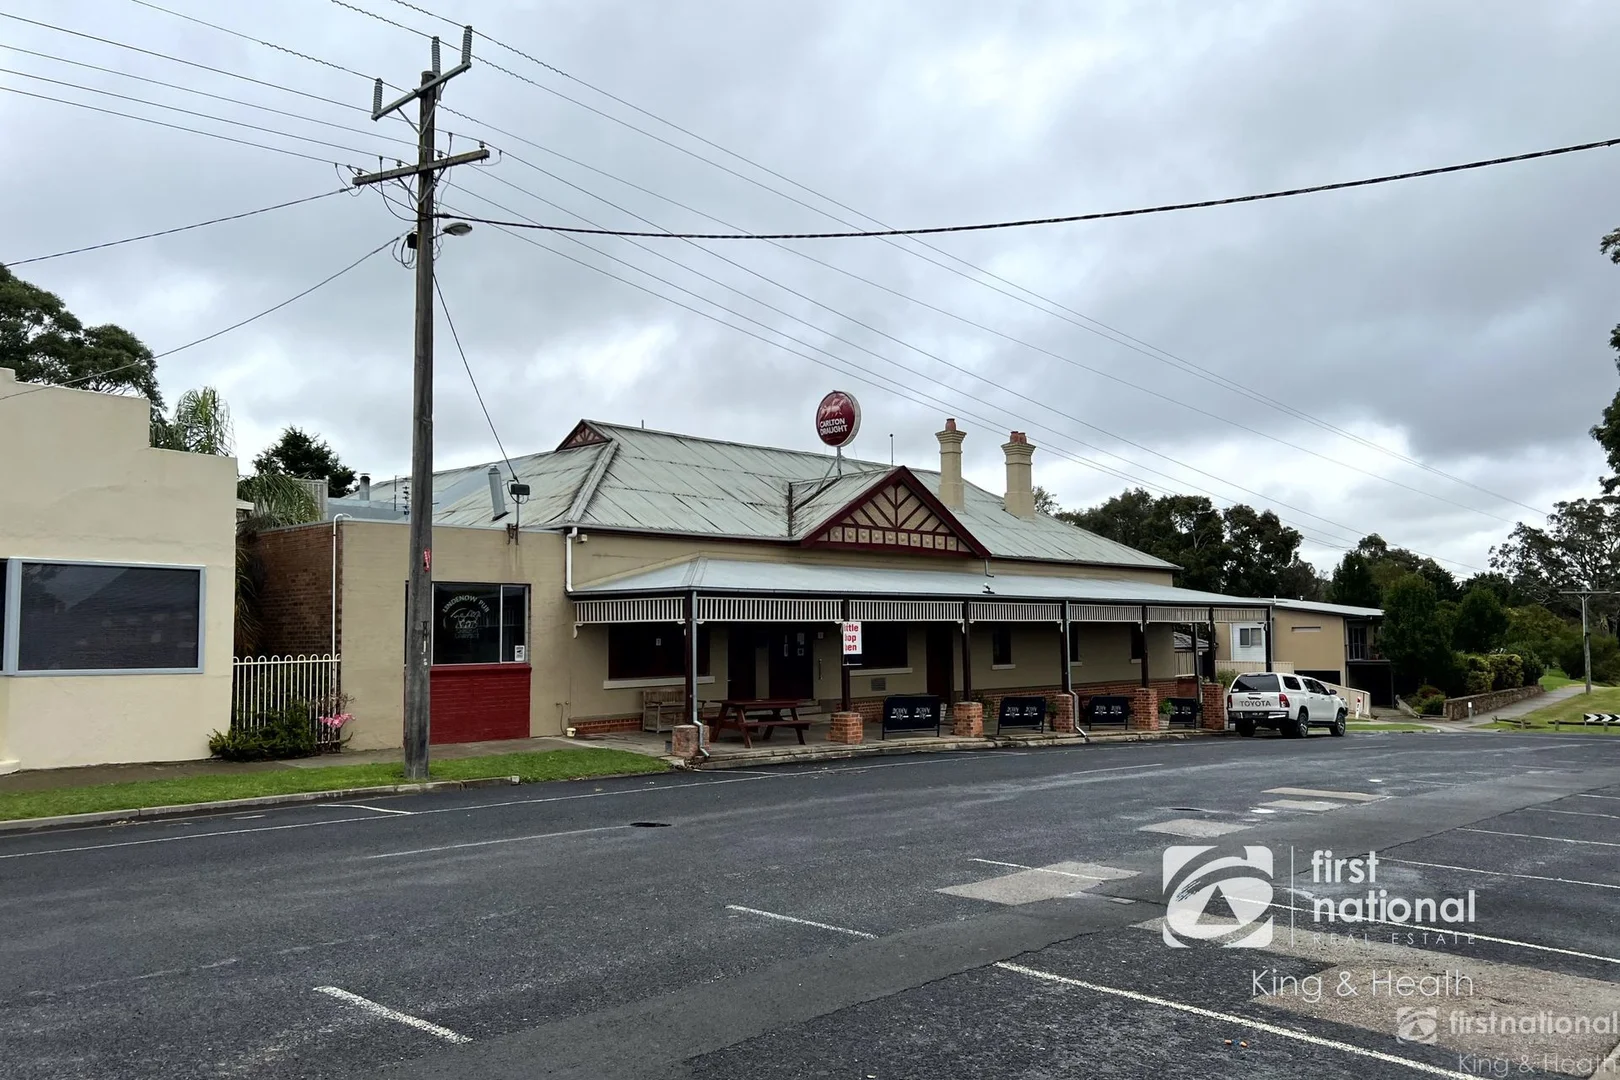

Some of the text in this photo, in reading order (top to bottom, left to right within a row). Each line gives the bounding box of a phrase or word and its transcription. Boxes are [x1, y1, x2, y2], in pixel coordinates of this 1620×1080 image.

[819, 418, 846, 428] CARLTON
[820, 425, 848, 436] DRAUGHT
[442, 595, 490, 613] LINDENOW PUB
